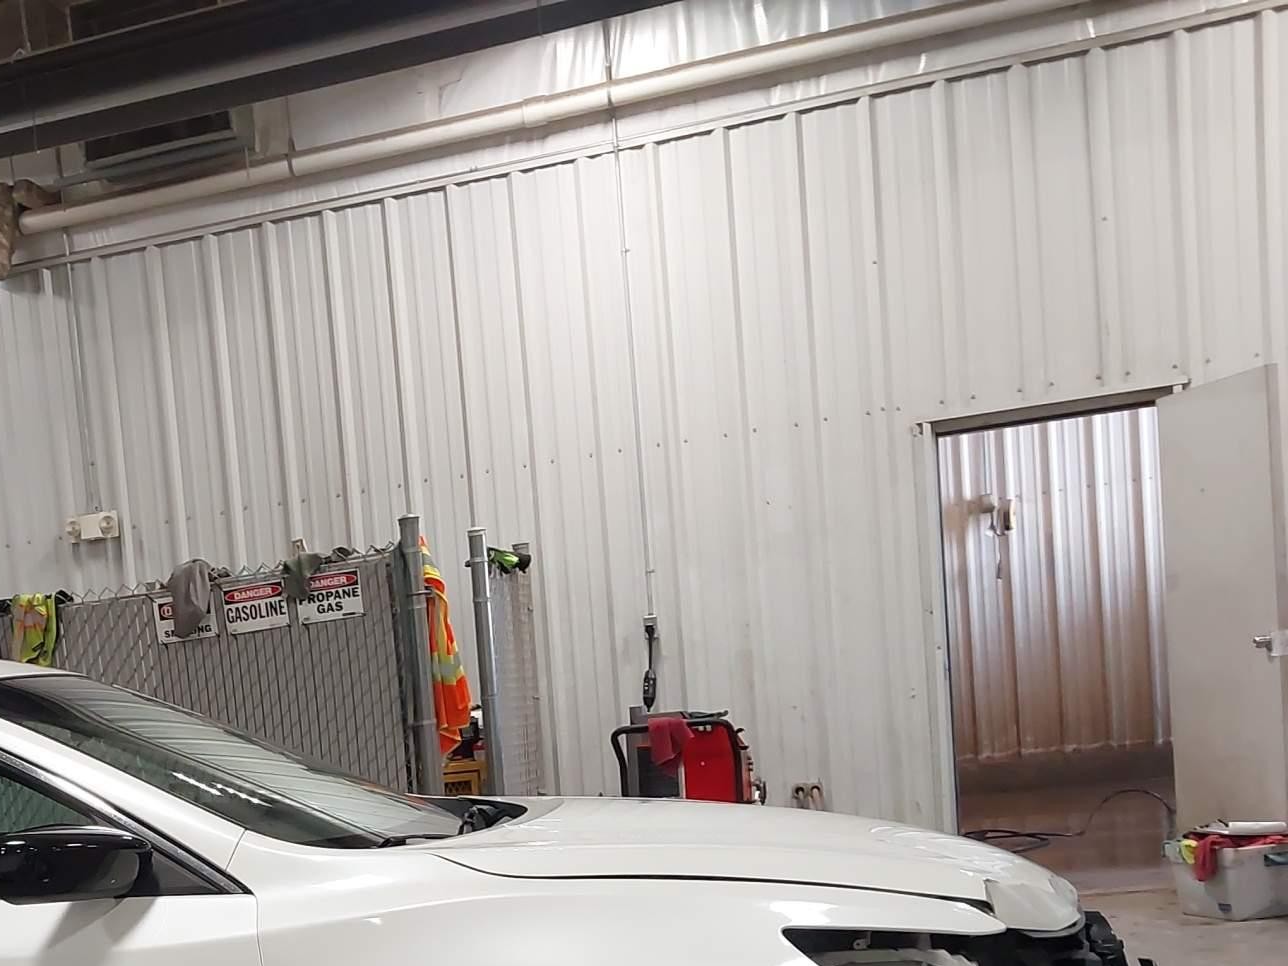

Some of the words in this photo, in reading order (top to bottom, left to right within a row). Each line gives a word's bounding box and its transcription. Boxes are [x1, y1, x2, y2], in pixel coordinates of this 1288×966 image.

[234, 587, 272, 600] DANGER
[226, 599, 287, 624] GASOLINE
[316, 601, 344, 614] GAS
